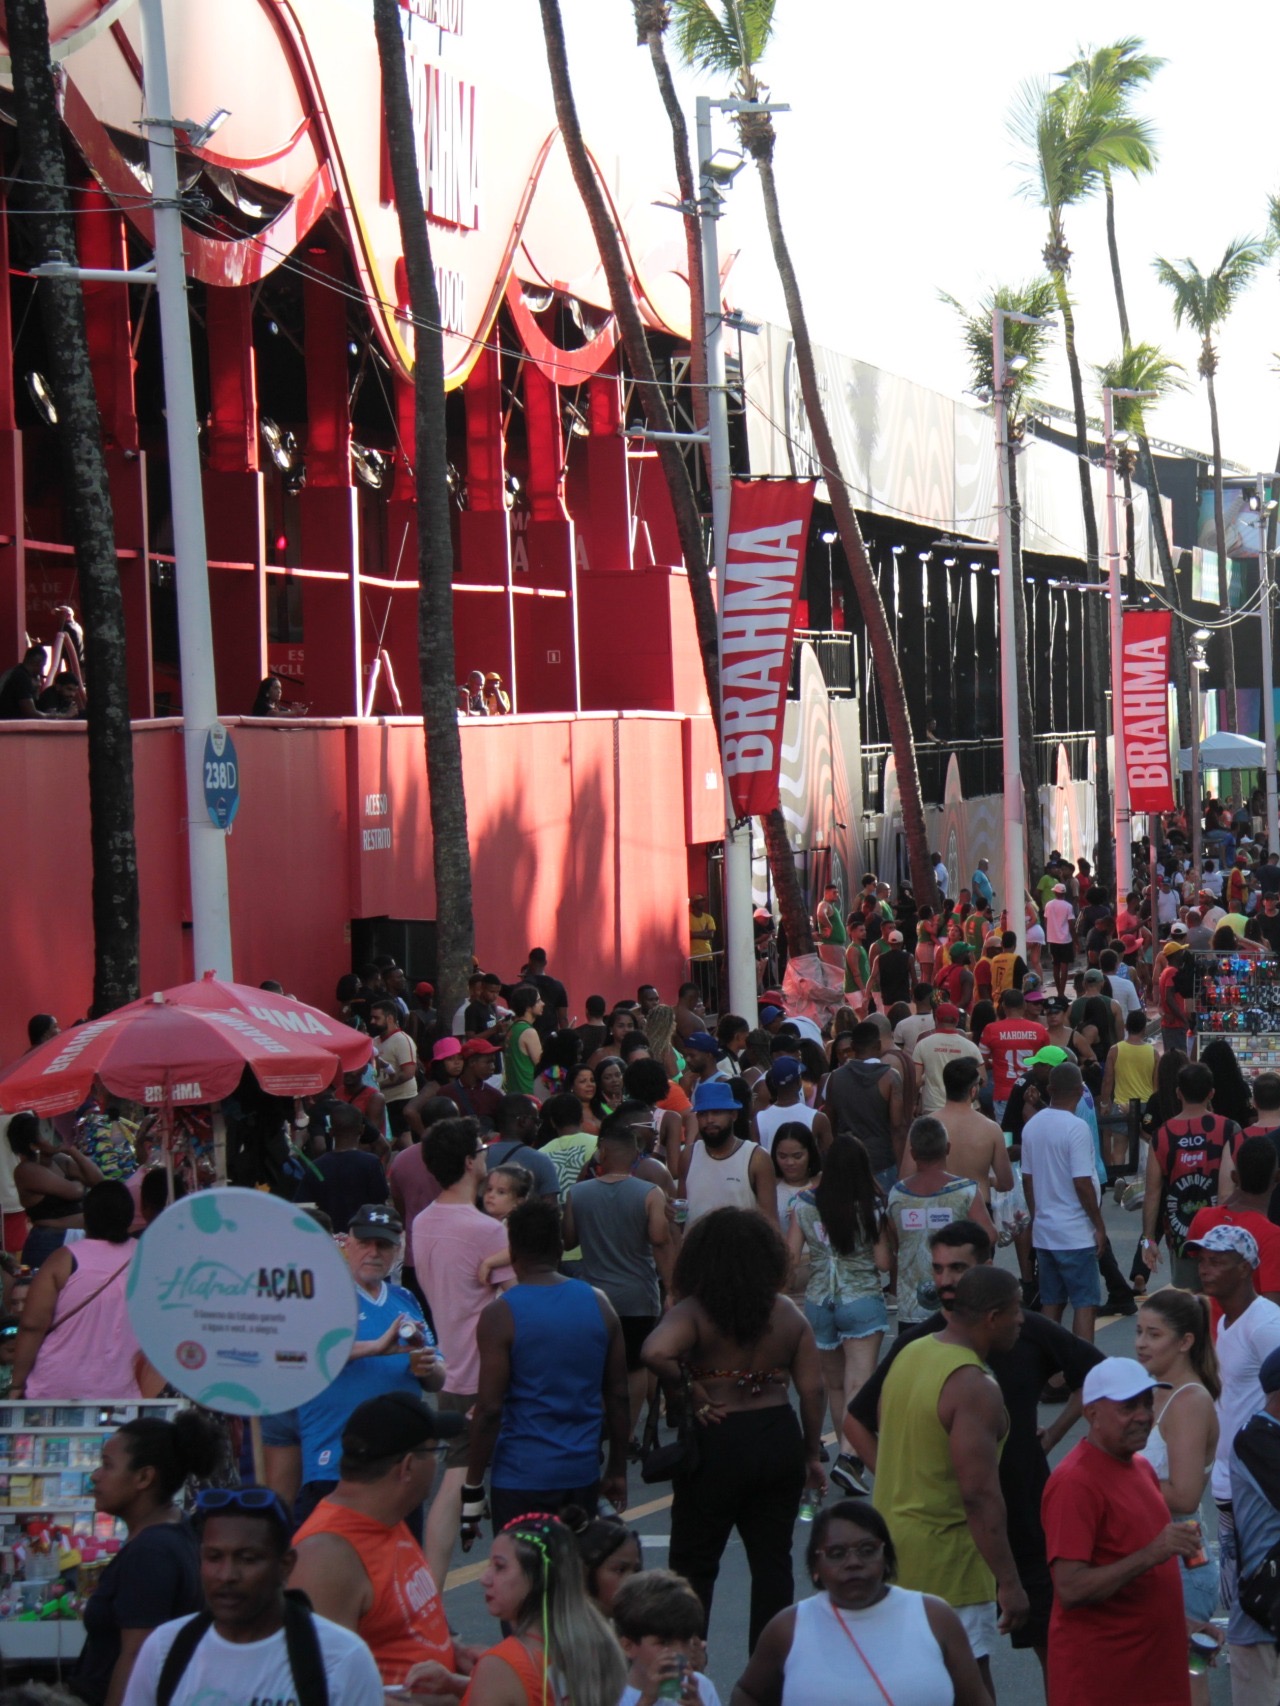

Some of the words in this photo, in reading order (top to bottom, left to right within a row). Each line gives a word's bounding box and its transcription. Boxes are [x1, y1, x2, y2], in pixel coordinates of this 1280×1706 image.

[723, 519, 803, 777] BRAHMA
[1123, 636, 1169, 788] BRAHMA
[205, 762, 237, 789] 238D
[365, 794, 388, 815] ACESSO
[362, 828, 392, 851] RESTRITO
[999, 1031, 1038, 1040] MAHOMES
[1004, 1049, 1034, 1079] 15
